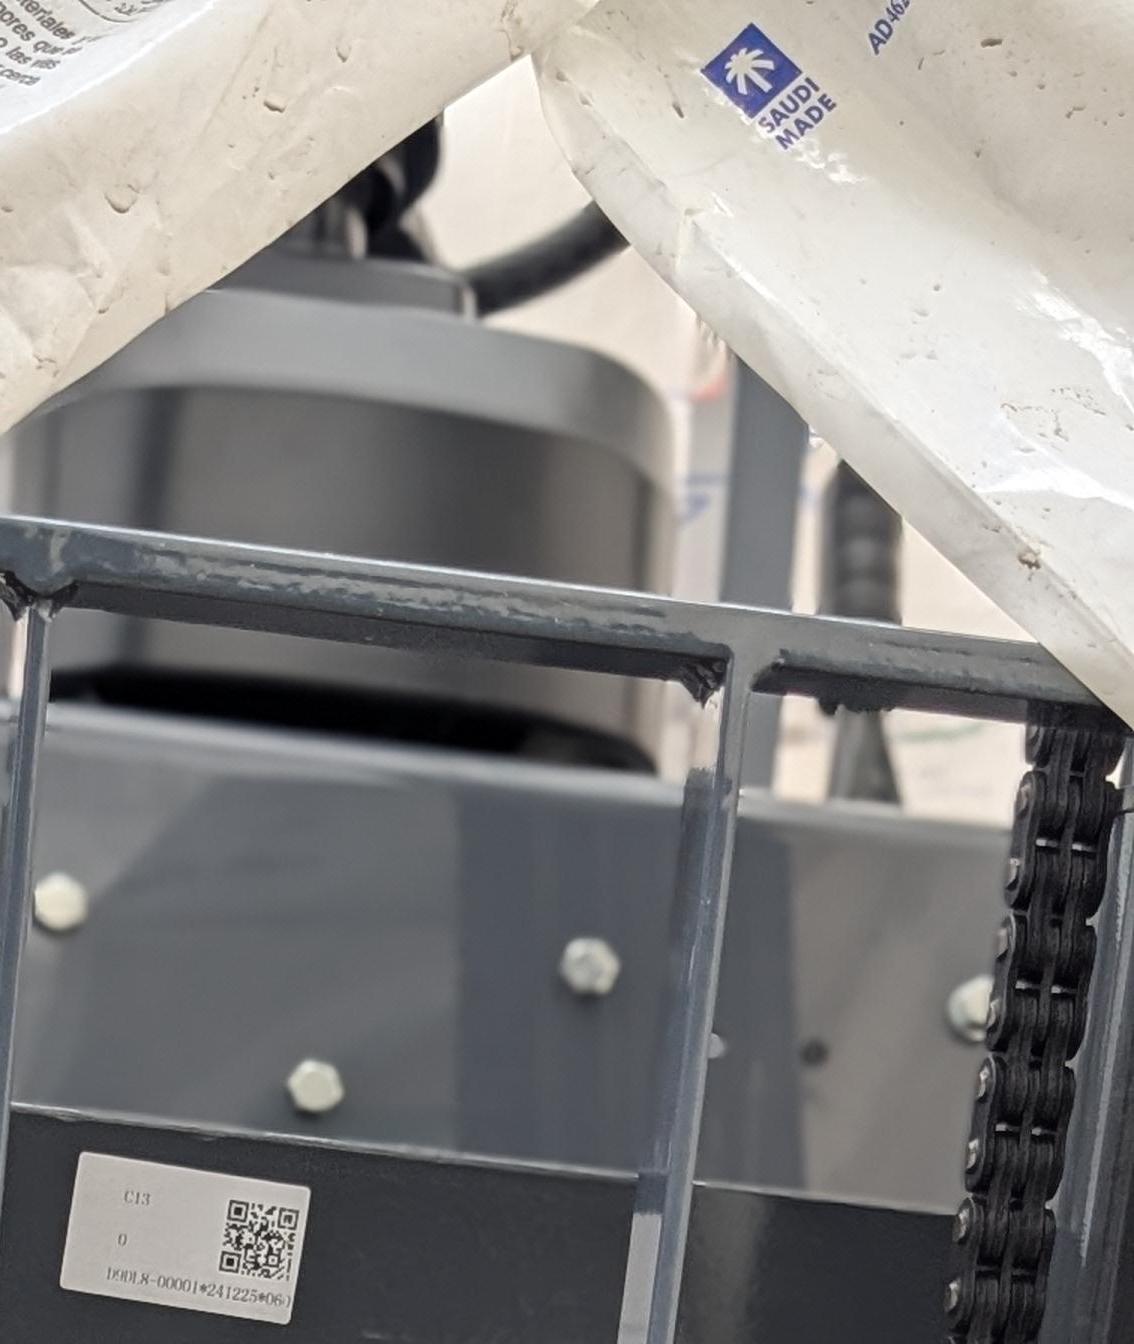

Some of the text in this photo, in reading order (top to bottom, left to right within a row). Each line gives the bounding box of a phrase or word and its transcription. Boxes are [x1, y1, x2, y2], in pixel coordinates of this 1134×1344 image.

[4, 45, 32, 65] las
[756, 76, 820, 134] SAUDI
[774, 92, 837, 150] MADE
[123, 1189, 151, 1206] C13
